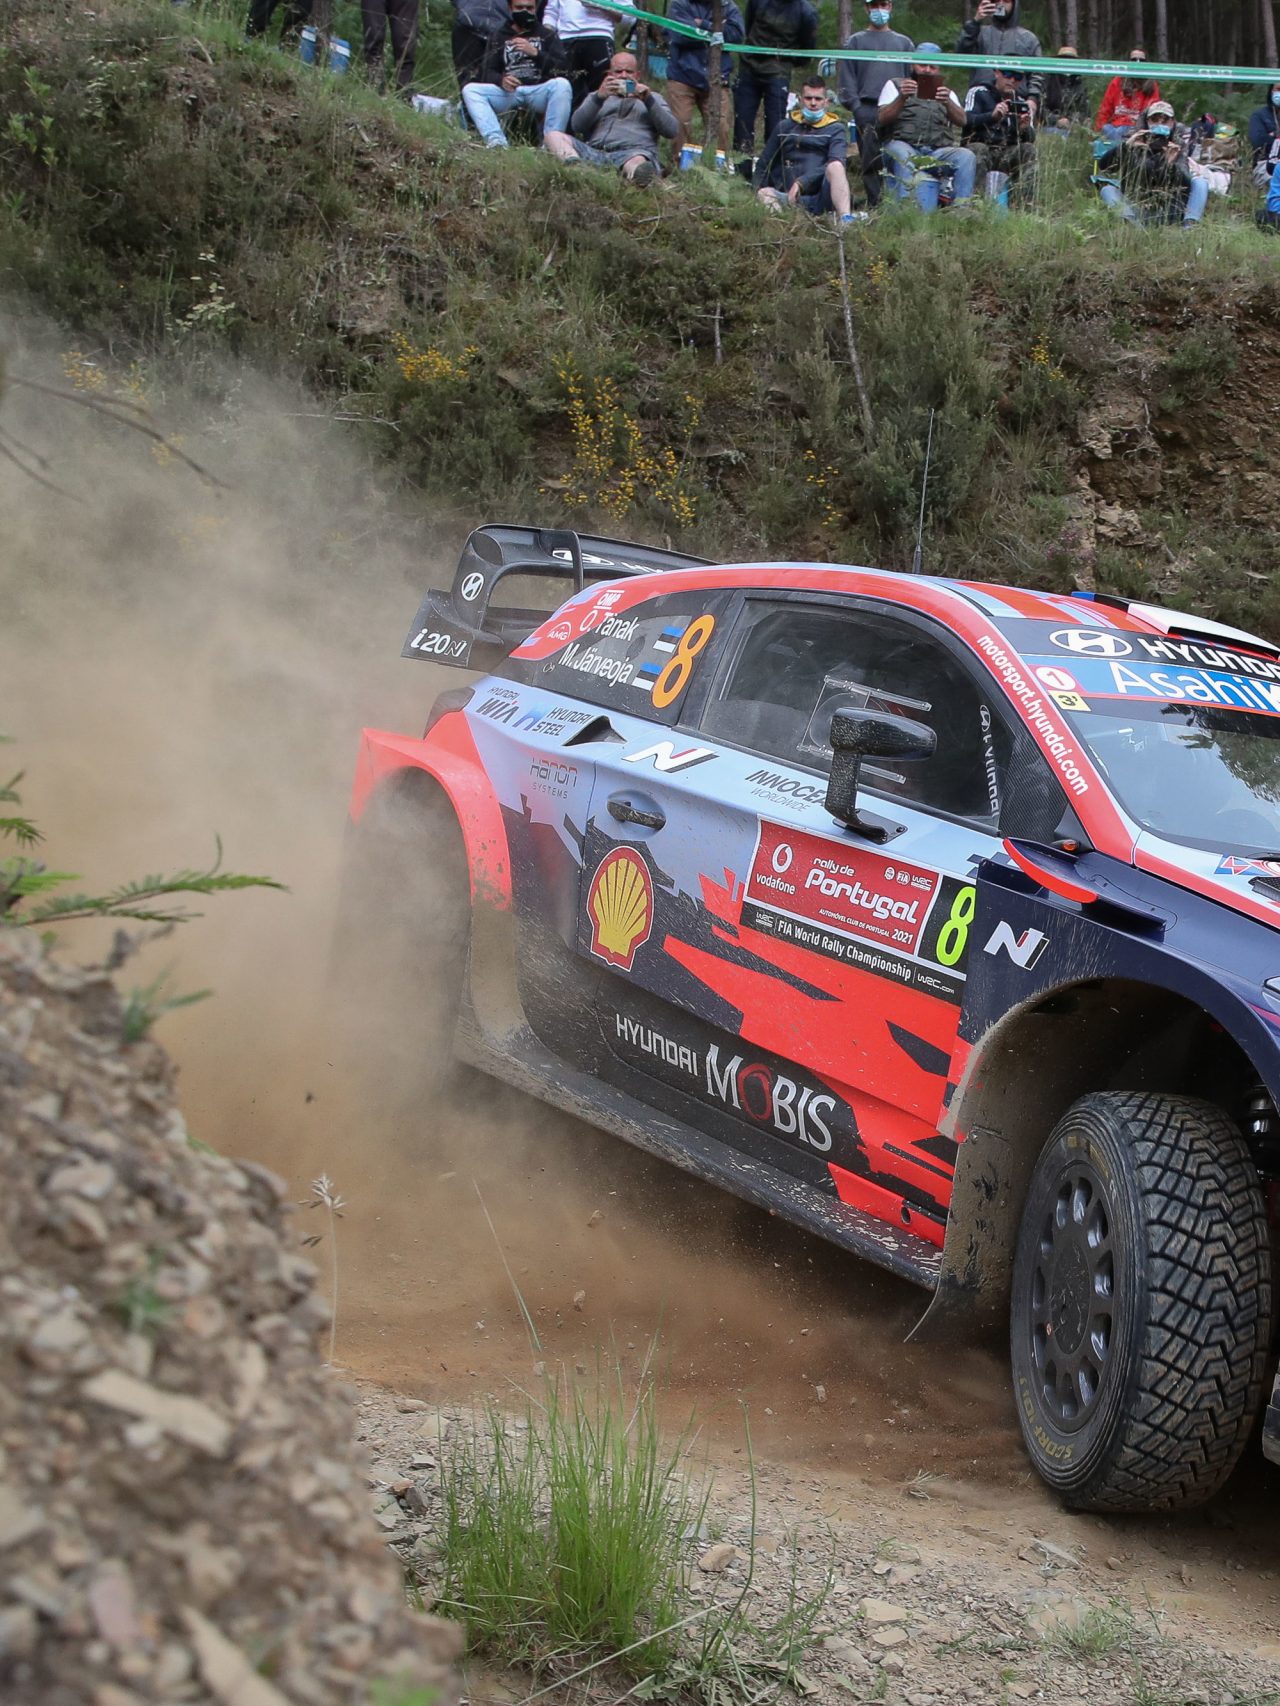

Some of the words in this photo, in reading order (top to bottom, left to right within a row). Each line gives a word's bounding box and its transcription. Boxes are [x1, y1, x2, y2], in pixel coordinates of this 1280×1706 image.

[597, 592, 622, 607] OMP
[547, 629, 569, 641] AMG
[580, 610, 597, 632] O.
[595, 612, 639, 641] Tänak
[652, 614, 715, 709] 8
[475, 697, 520, 724] WIA
[546, 707, 594, 724] HYUNDAI
[977, 635, 1089, 796] motorsport.hyundai.com
[532, 721, 565, 736] STEEL
[532, 782, 568, 799] SYSTEMS
[745, 770, 827, 807] INNOCE
[751, 787, 811, 812] WORLDWIDE
[813, 858, 840, 873] rally
[840, 865, 855, 876] de
[756, 873, 795, 895] vodafone
[804, 868, 919, 924] Portugal
[846, 917, 859, 927] CLUB
[859, 921, 865, 929] DE
[865, 923, 890, 937] PORTUGAL
[892, 929, 913, 944] 2021
[936, 886, 976, 966] 8
[777, 920, 792, 936] FIA
[794, 925, 820, 945] World
[821, 935, 845, 957] Rally
[847, 945, 912, 982] Championship
[616, 1013, 698, 1076] HYUNDAI
[706, 1043, 836, 1152] MOBIS
